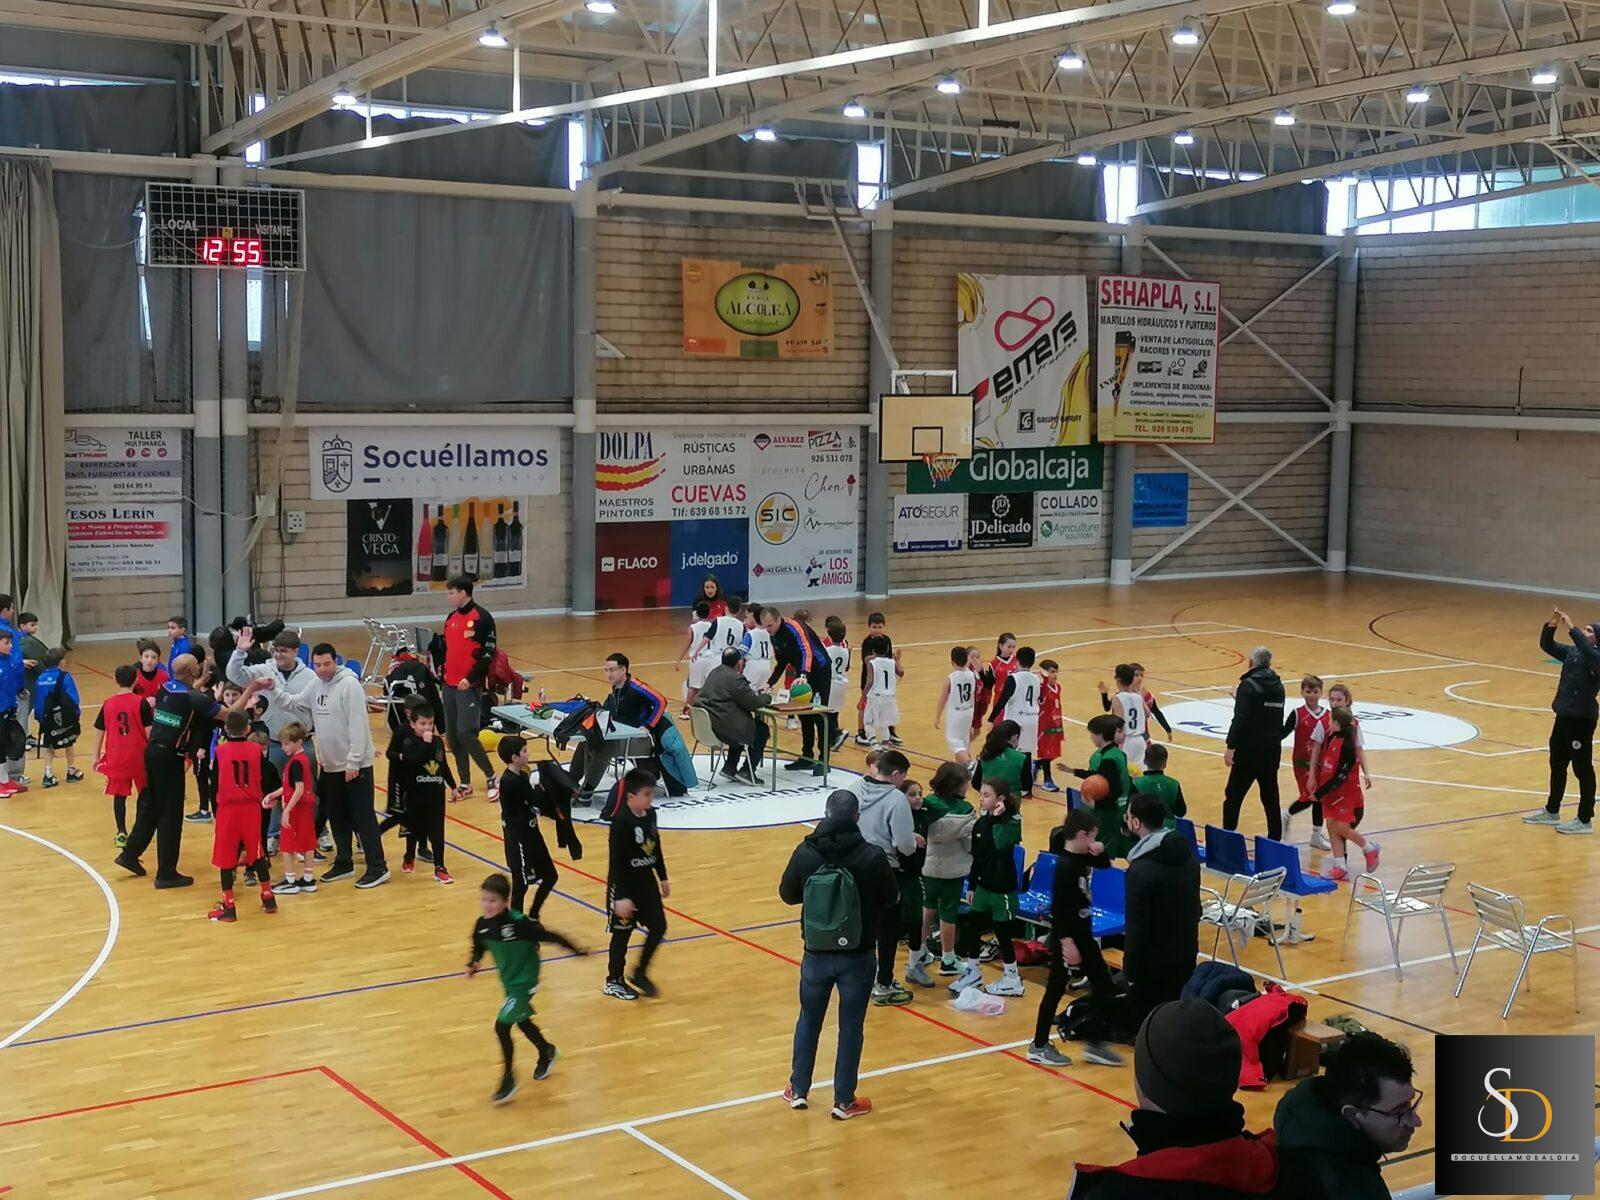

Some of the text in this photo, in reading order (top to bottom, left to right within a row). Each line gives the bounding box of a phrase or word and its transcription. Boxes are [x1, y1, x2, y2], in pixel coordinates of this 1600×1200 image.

[161, 219, 292, 237] LOCAL VISITANTE
[203, 240, 260, 263] 12 55
[1101, 279, 1216, 314] SEHAPLA, S.L.
[726, 301, 791, 317] ALCOLEA
[1100, 315, 1136, 326] MARTILLOS
[1179, 320, 1184, 329] Y
[1185, 320, 1217, 331] PUNTEROS
[1140, 335, 1216, 348] VENTA DE LATIGUILLOS,
[1139, 346, 1211, 358] RACORES Y ENCHUFES
[1132, 382, 1171, 390] IMPLEMENTOS
[129, 431, 162, 440] TALLER
[1134, 425, 1149, 433] TEL.
[600, 432, 653, 460] DOLPA
[683, 441, 736, 454] RÚSTICAS
[808, 430, 841, 450] PIZZA
[364, 442, 548, 468] Socuéllamos
[811, 455, 853, 463] 926 531 078
[683, 464, 736, 475] URBANAS
[970, 450, 1089, 488] Globalcaja
[386, 474, 545, 484] AYUNTAMIENTO
[672, 484, 747, 503] CUEVAS
[599, 498, 654, 507] MAESTROS
[690, 507, 706, 516] 639
[723, 506, 733, 515] 15
[735, 505, 746, 515] 72
[1041, 496, 1099, 509] COLLADO
[599, 509, 654, 518] PINTORES
[761, 508, 793, 522] SIC
[1053, 520, 1099, 536] Agriculture
[362, 533, 396, 544] CRISTO
[363, 543, 400, 555] VEGA
[617, 557, 658, 569] FLACO
[681, 551, 738, 570] j.delgado
[829, 557, 849, 570] LOS
[821, 571, 853, 586] AMIGOS
[760, 641, 769, 660] 11
[836, 656, 843, 675] 2
[883, 670, 889, 690] 1
[957, 682, 972, 704] 13
[1025, 685, 1034, 707] 4
[117, 711, 130, 736] 3
[1129, 707, 1138, 730] 3
[232, 759, 249, 790] 11
[634, 826, 645, 845] 8
